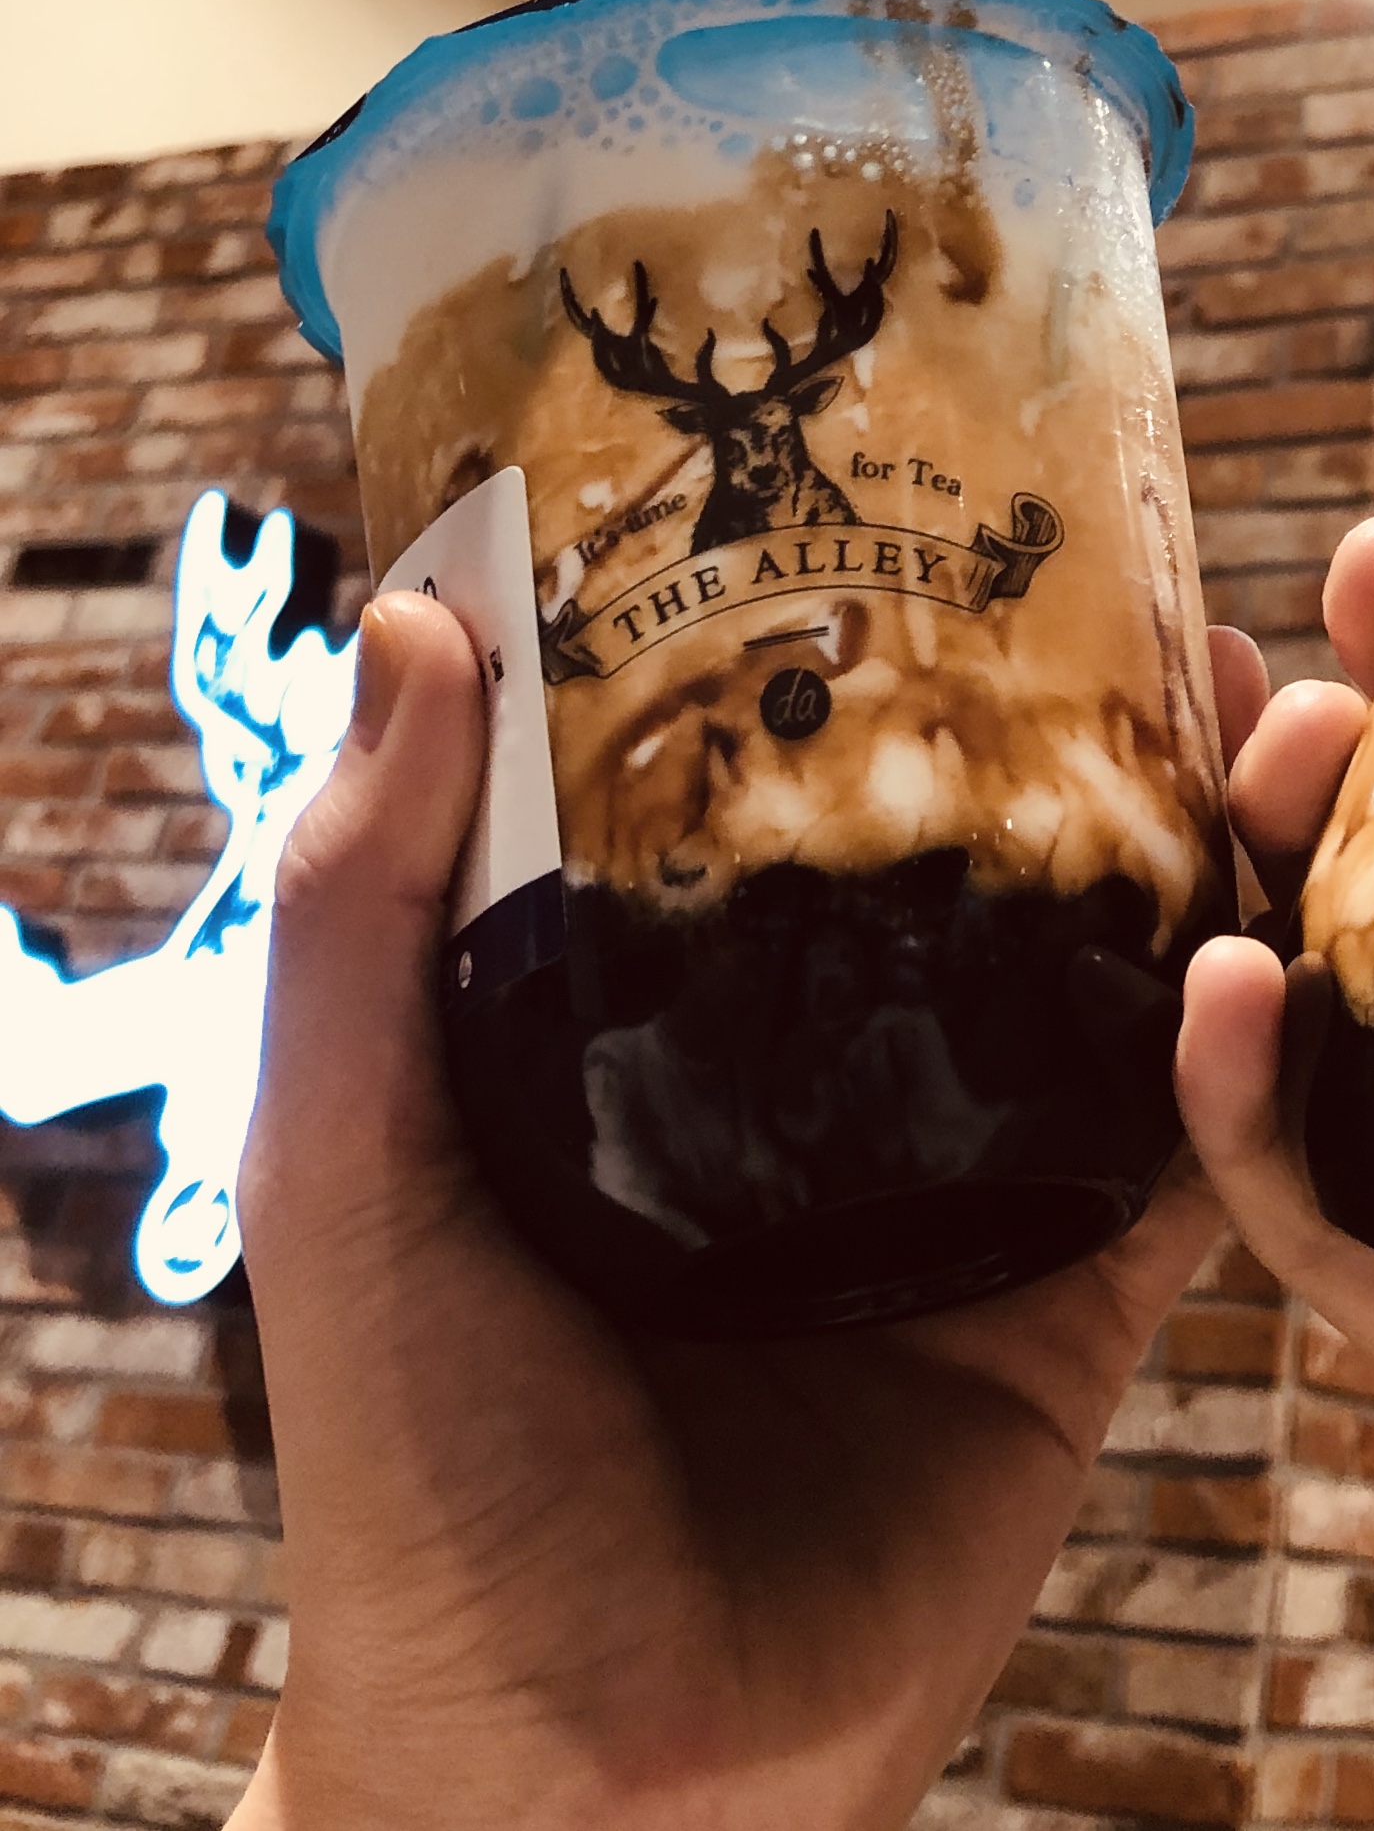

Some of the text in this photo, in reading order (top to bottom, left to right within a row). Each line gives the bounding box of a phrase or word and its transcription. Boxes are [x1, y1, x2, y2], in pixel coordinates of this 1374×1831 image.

[850, 452, 963, 497] for Tea
[612, 540, 950, 644] THE ALLEY
